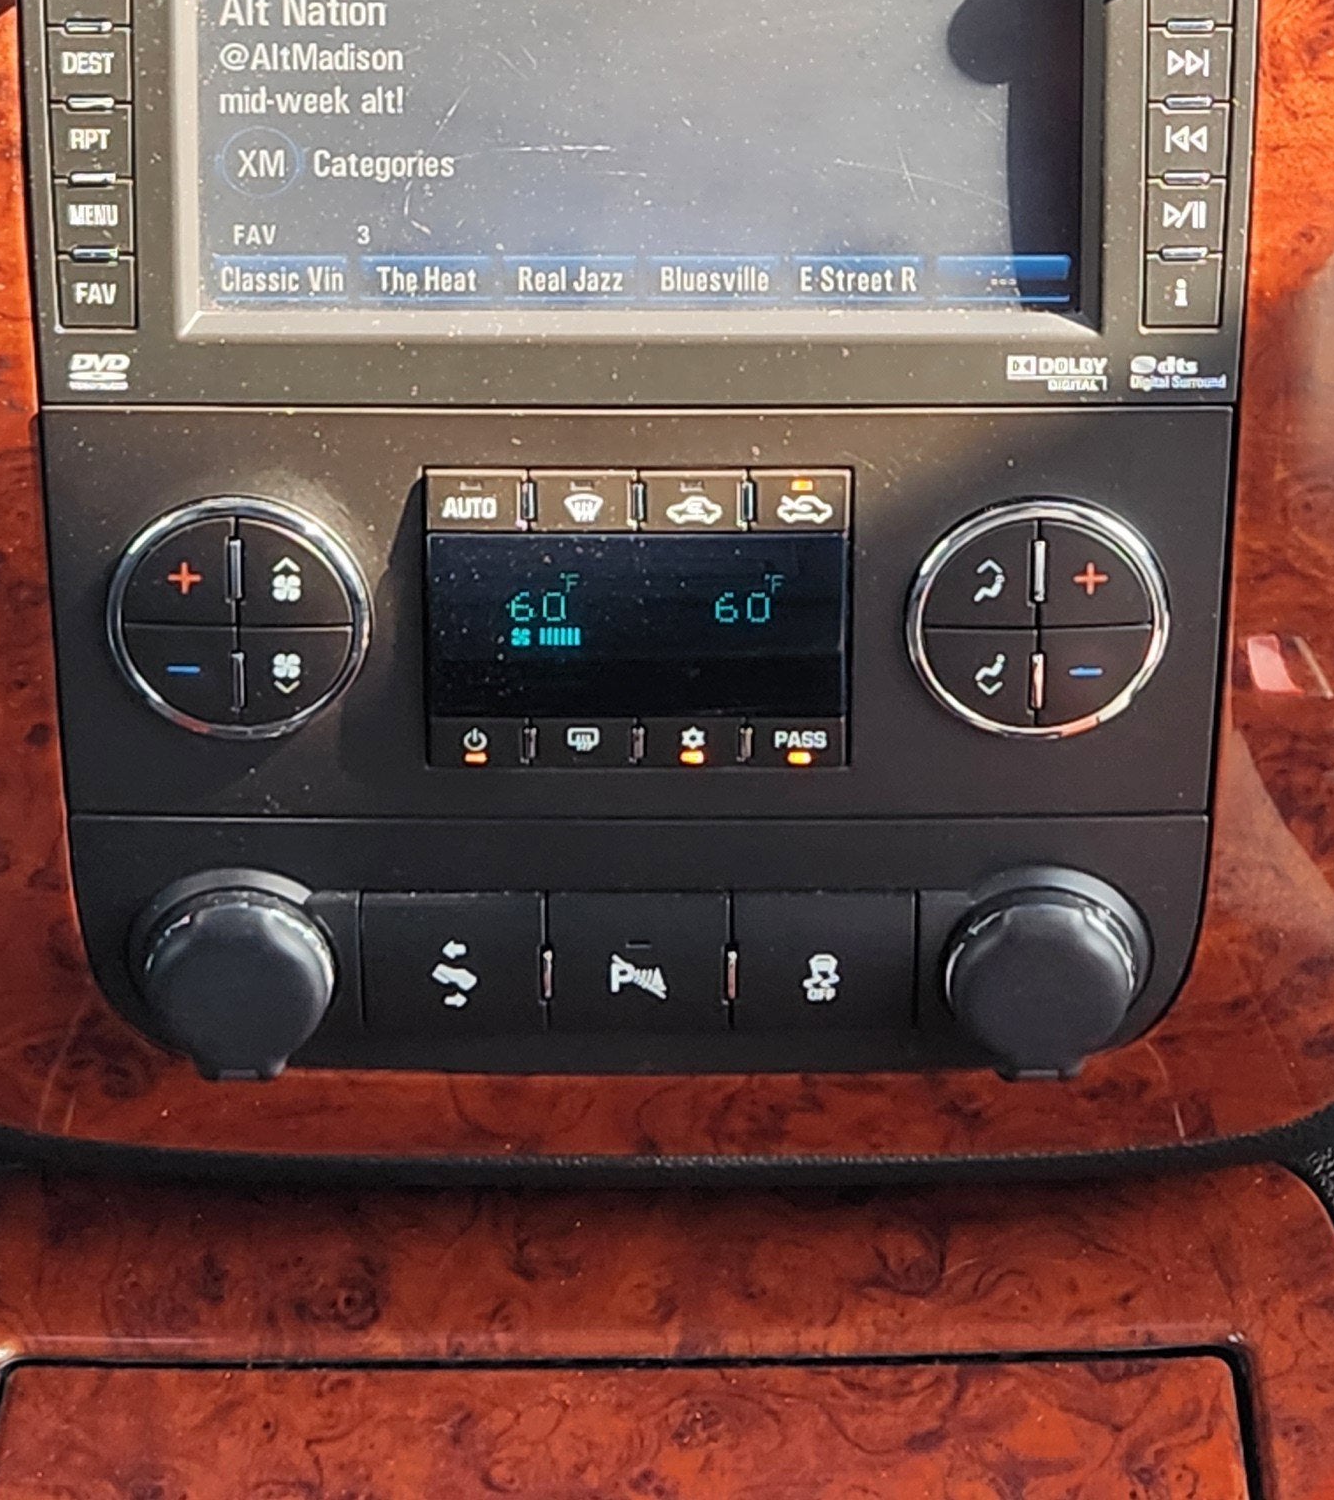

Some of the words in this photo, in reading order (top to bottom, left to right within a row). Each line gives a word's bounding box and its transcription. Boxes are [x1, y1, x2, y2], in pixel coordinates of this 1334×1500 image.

[62, 51, 114, 74] DEST
[219, 43, 404, 71] @AltMadison
[219, 86, 351, 115] mid-week
[360, 86, 404, 115] alt!
[70, 128, 111, 150] RPT
[238, 149, 286, 177] XM
[313, 149, 455, 182] Categories
[69, 204, 118, 226] MENU
[233, 224, 277, 245] FAV
[357, 225, 371, 245] 3
[221, 266, 299, 293] Classic
[307, 266, 344, 292] Vin
[376, 266, 417, 293] The
[424, 266, 477, 292] Heat
[518, 266, 566, 292] Real
[573, 266, 623, 293] Jazz
[660, 266, 769, 293] Bluesville
[800, 266, 813, 292] E
[820, 266, 893, 292] Street
[901, 266, 917, 292] R
[75, 282, 116, 305] FAV
[70, 353, 131, 372] DVD
[1038, 356, 1108, 375] DOLBY
[1157, 356, 1198, 375] dts
[1047, 378, 1099, 392] DIGITAL
[1130, 375, 1170, 392] Digital
[1171, 374, 1227, 390] Surround
[442, 496, 497, 520] AUTO
[774, 730, 827, 750] PASS
[806, 987, 837, 1002] OFF
